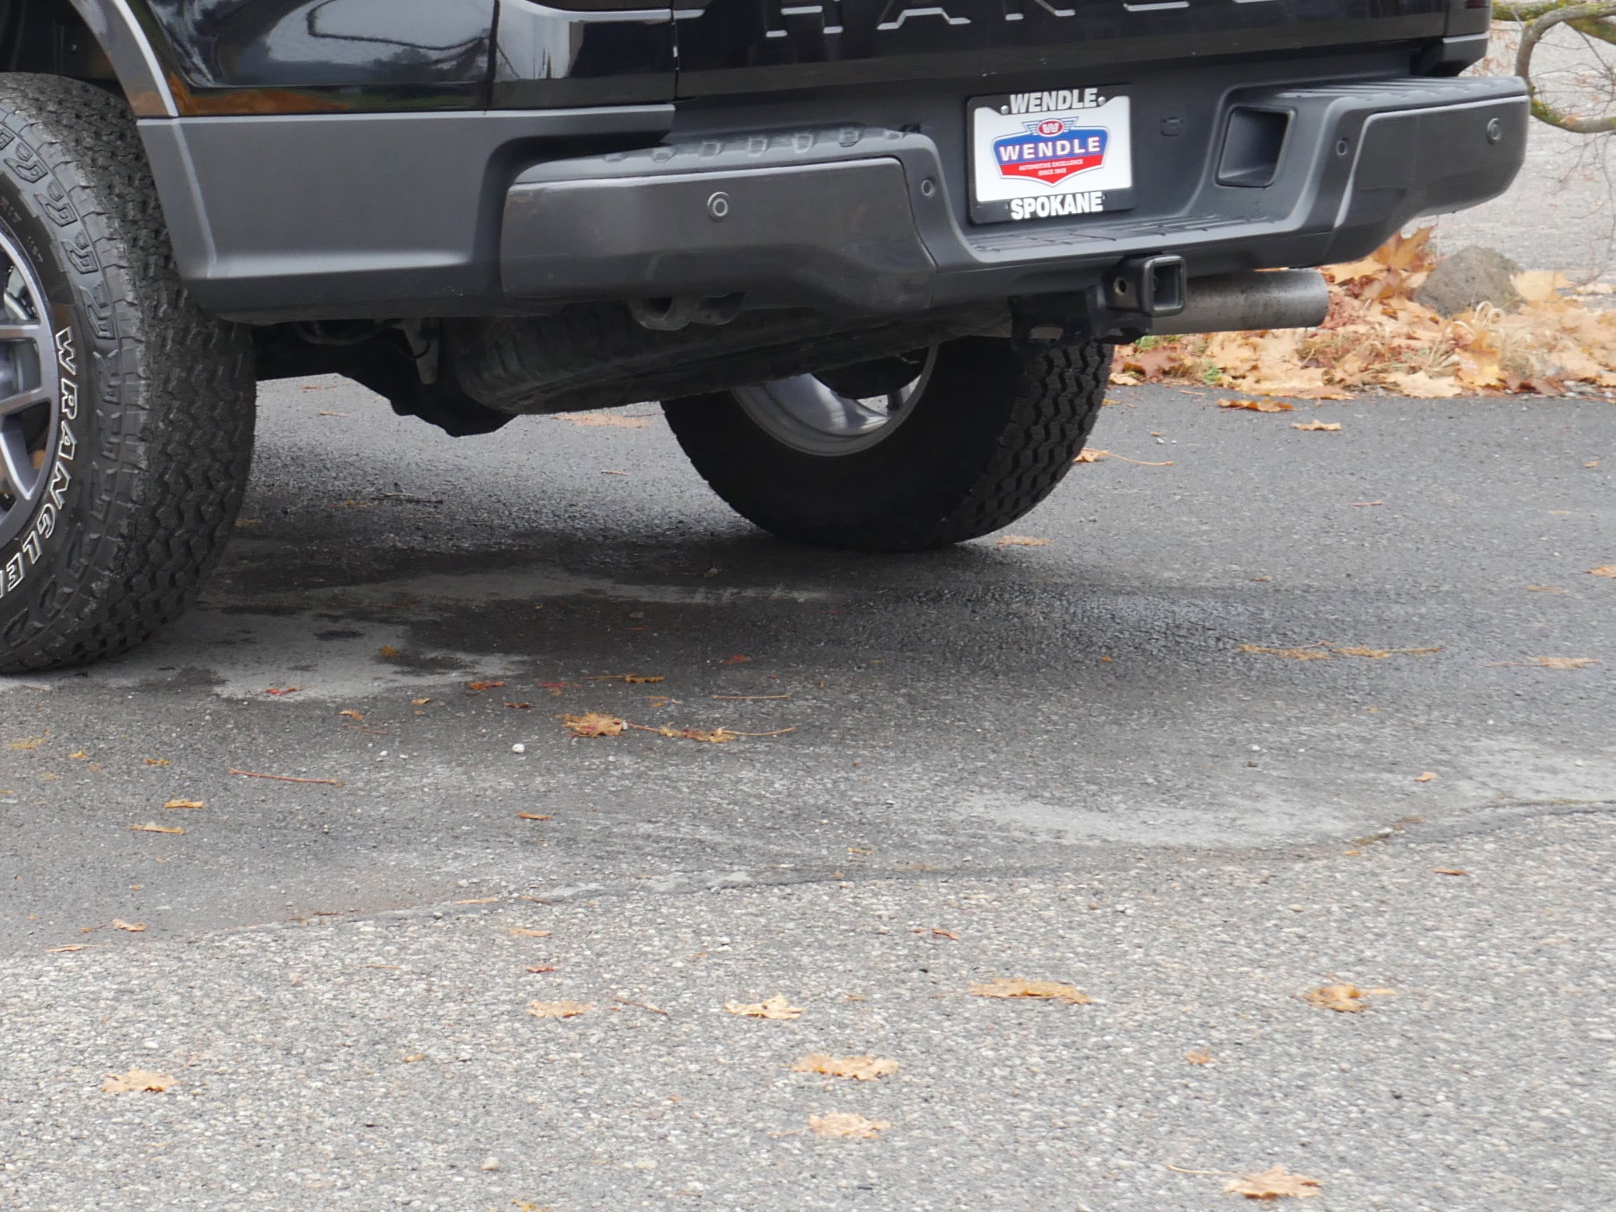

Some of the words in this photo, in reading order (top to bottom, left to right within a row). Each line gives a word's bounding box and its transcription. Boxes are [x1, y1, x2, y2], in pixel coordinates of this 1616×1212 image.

[1009, 88, 1098, 115] WENDLE
[999, 137, 1100, 161] WENDLE
[1010, 191, 1104, 221] SPOKANE
